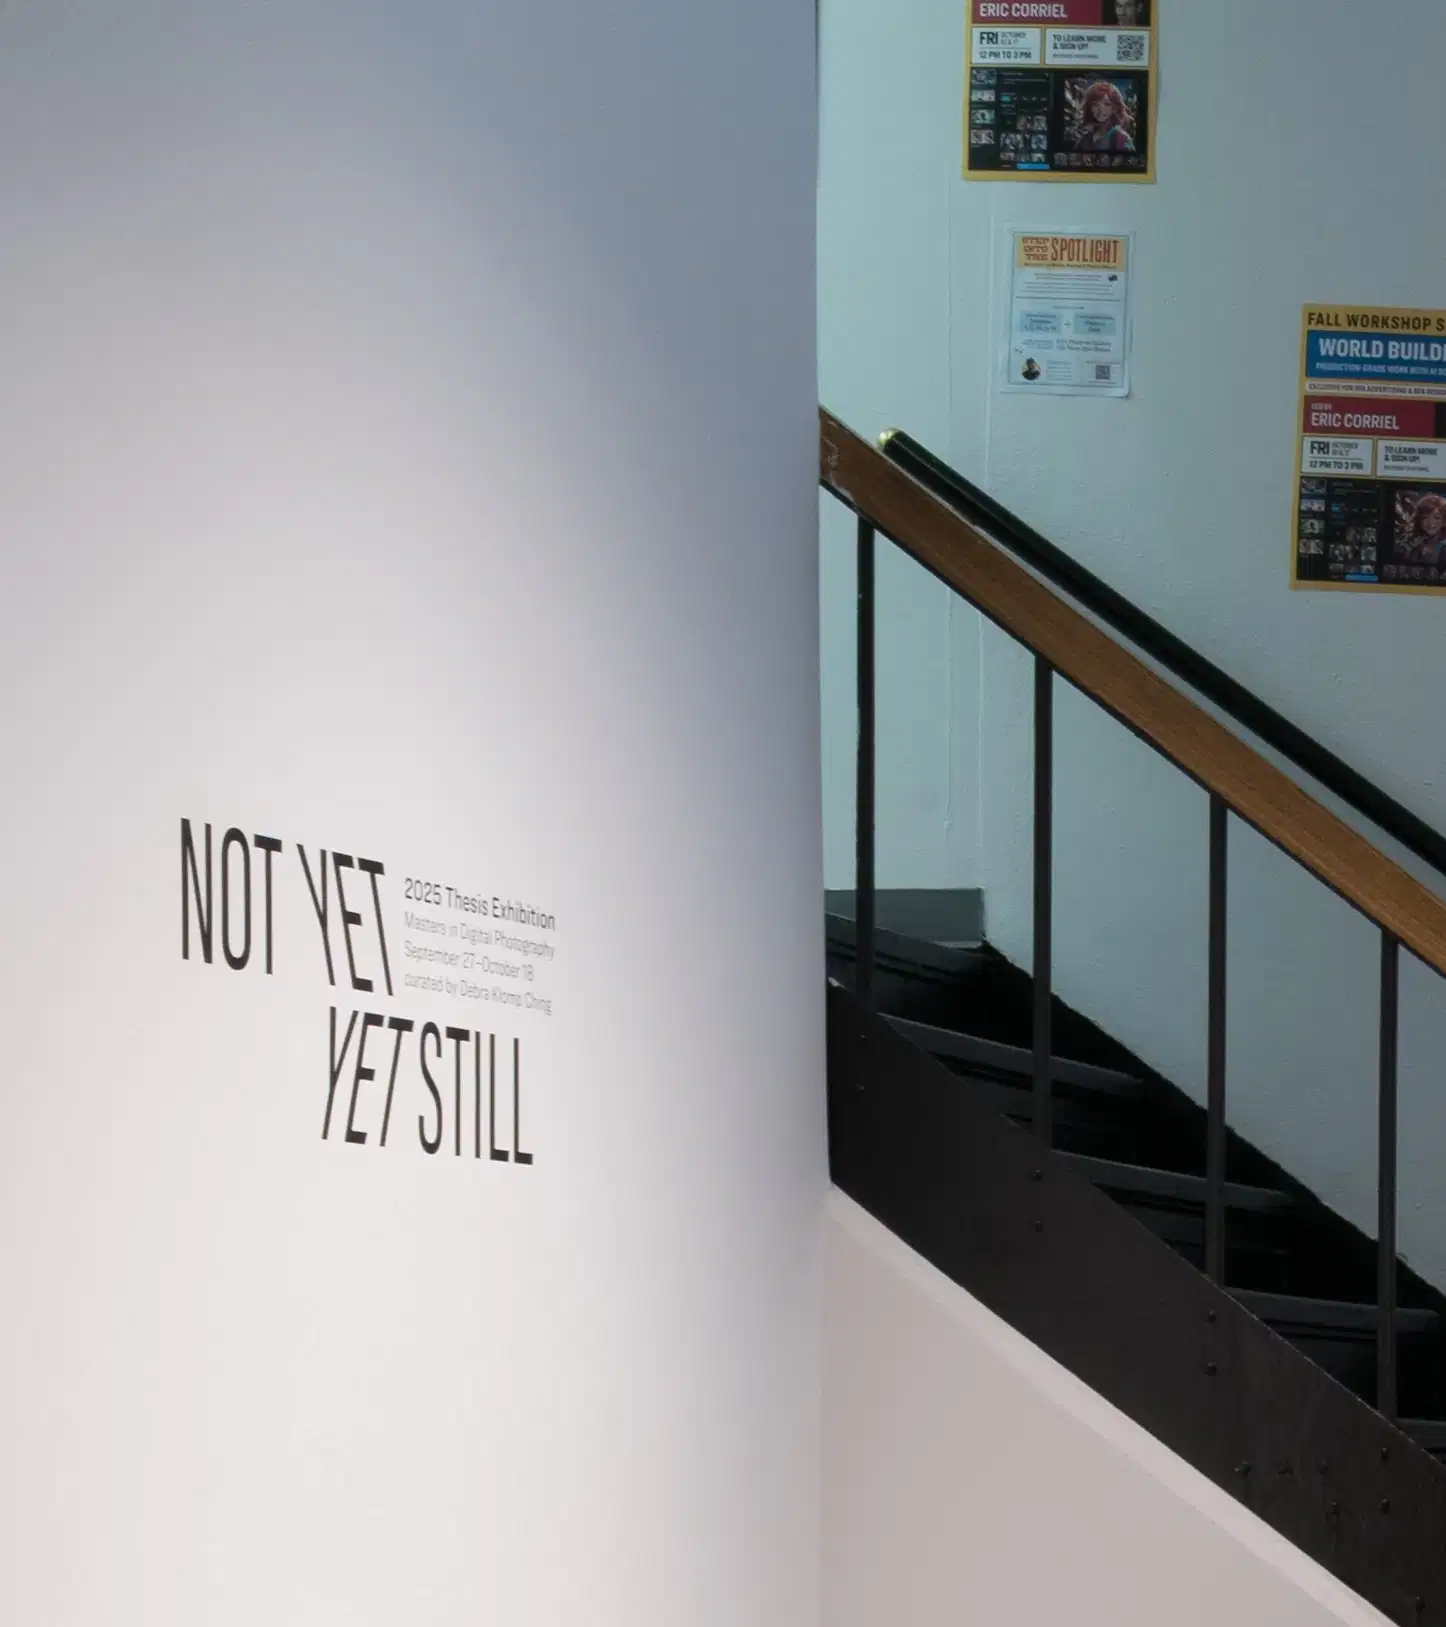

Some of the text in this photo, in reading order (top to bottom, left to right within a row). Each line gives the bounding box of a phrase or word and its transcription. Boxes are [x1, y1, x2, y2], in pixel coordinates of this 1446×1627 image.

[980, 3, 1068, 18] ERIC CORRIEL
[980, 32, 998, 44] FRI
[1051, 237, 1119, 263] SPOTLIGHT
[1307, 312, 1341, 326] FALL
[1346, 314, 1431, 330] WORKSHOP
[1318, 338, 1383, 358] WORLD
[1311, 412, 1399, 429] ERIC CORRIEL
[1310, 440, 1330, 455] FRI
[1333, 461, 1343, 469] TO
[1350, 462, 1363, 470] PM
[181, 818, 393, 996] NOT YET
[404, 877, 555, 930] 2025 Thesis Exhibition
[461, 922, 492, 945] Digital
[322, 1006, 533, 1165] YET STILL
